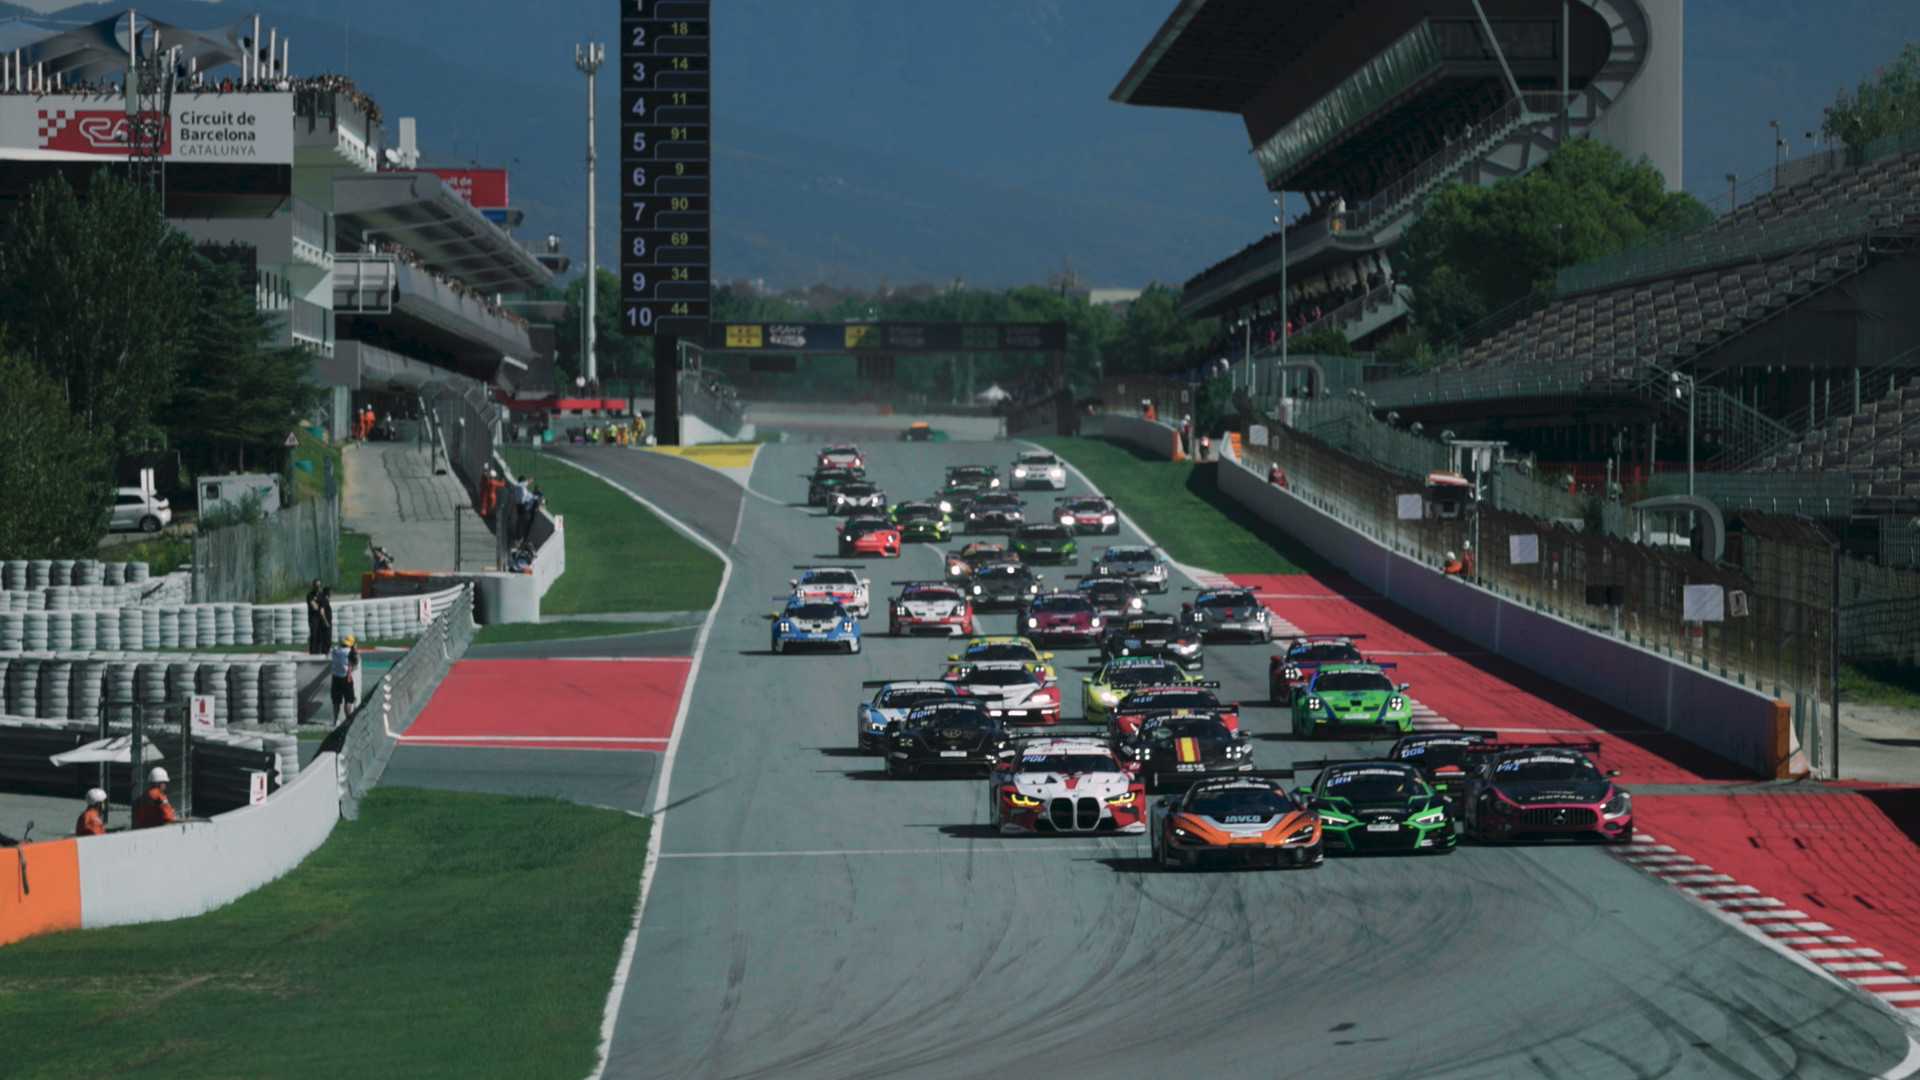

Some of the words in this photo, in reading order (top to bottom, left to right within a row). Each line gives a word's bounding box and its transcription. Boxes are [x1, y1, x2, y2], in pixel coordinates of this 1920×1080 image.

[632, 27, 646, 46] 2
[671, 22, 689, 36] 18
[632, 62, 646, 81] 3
[671, 57, 689, 71] 14
[632, 97, 646, 116] 4
[671, 92, 687, 105] 11
[180, 111, 234, 125] Circuit
[237, 111, 256, 125] de
[180, 127, 256, 141] Barcelona
[633, 132, 646, 151] 5
[671, 127, 688, 141] 91
[180, 144, 256, 157] CATALUNYA
[632, 167, 646, 186] 6
[675, 162, 684, 176] 9
[632, 202, 646, 221] 7
[671, 197, 689, 211] 90
[632, 237, 646, 256] 8
[671, 232, 689, 246] 69
[632, 272, 646, 291] 9
[671, 267, 689, 281] 34
[626, 307, 652, 327] 10
[671, 302, 689, 316] 44
[1021, 755, 1047, 763] POU
